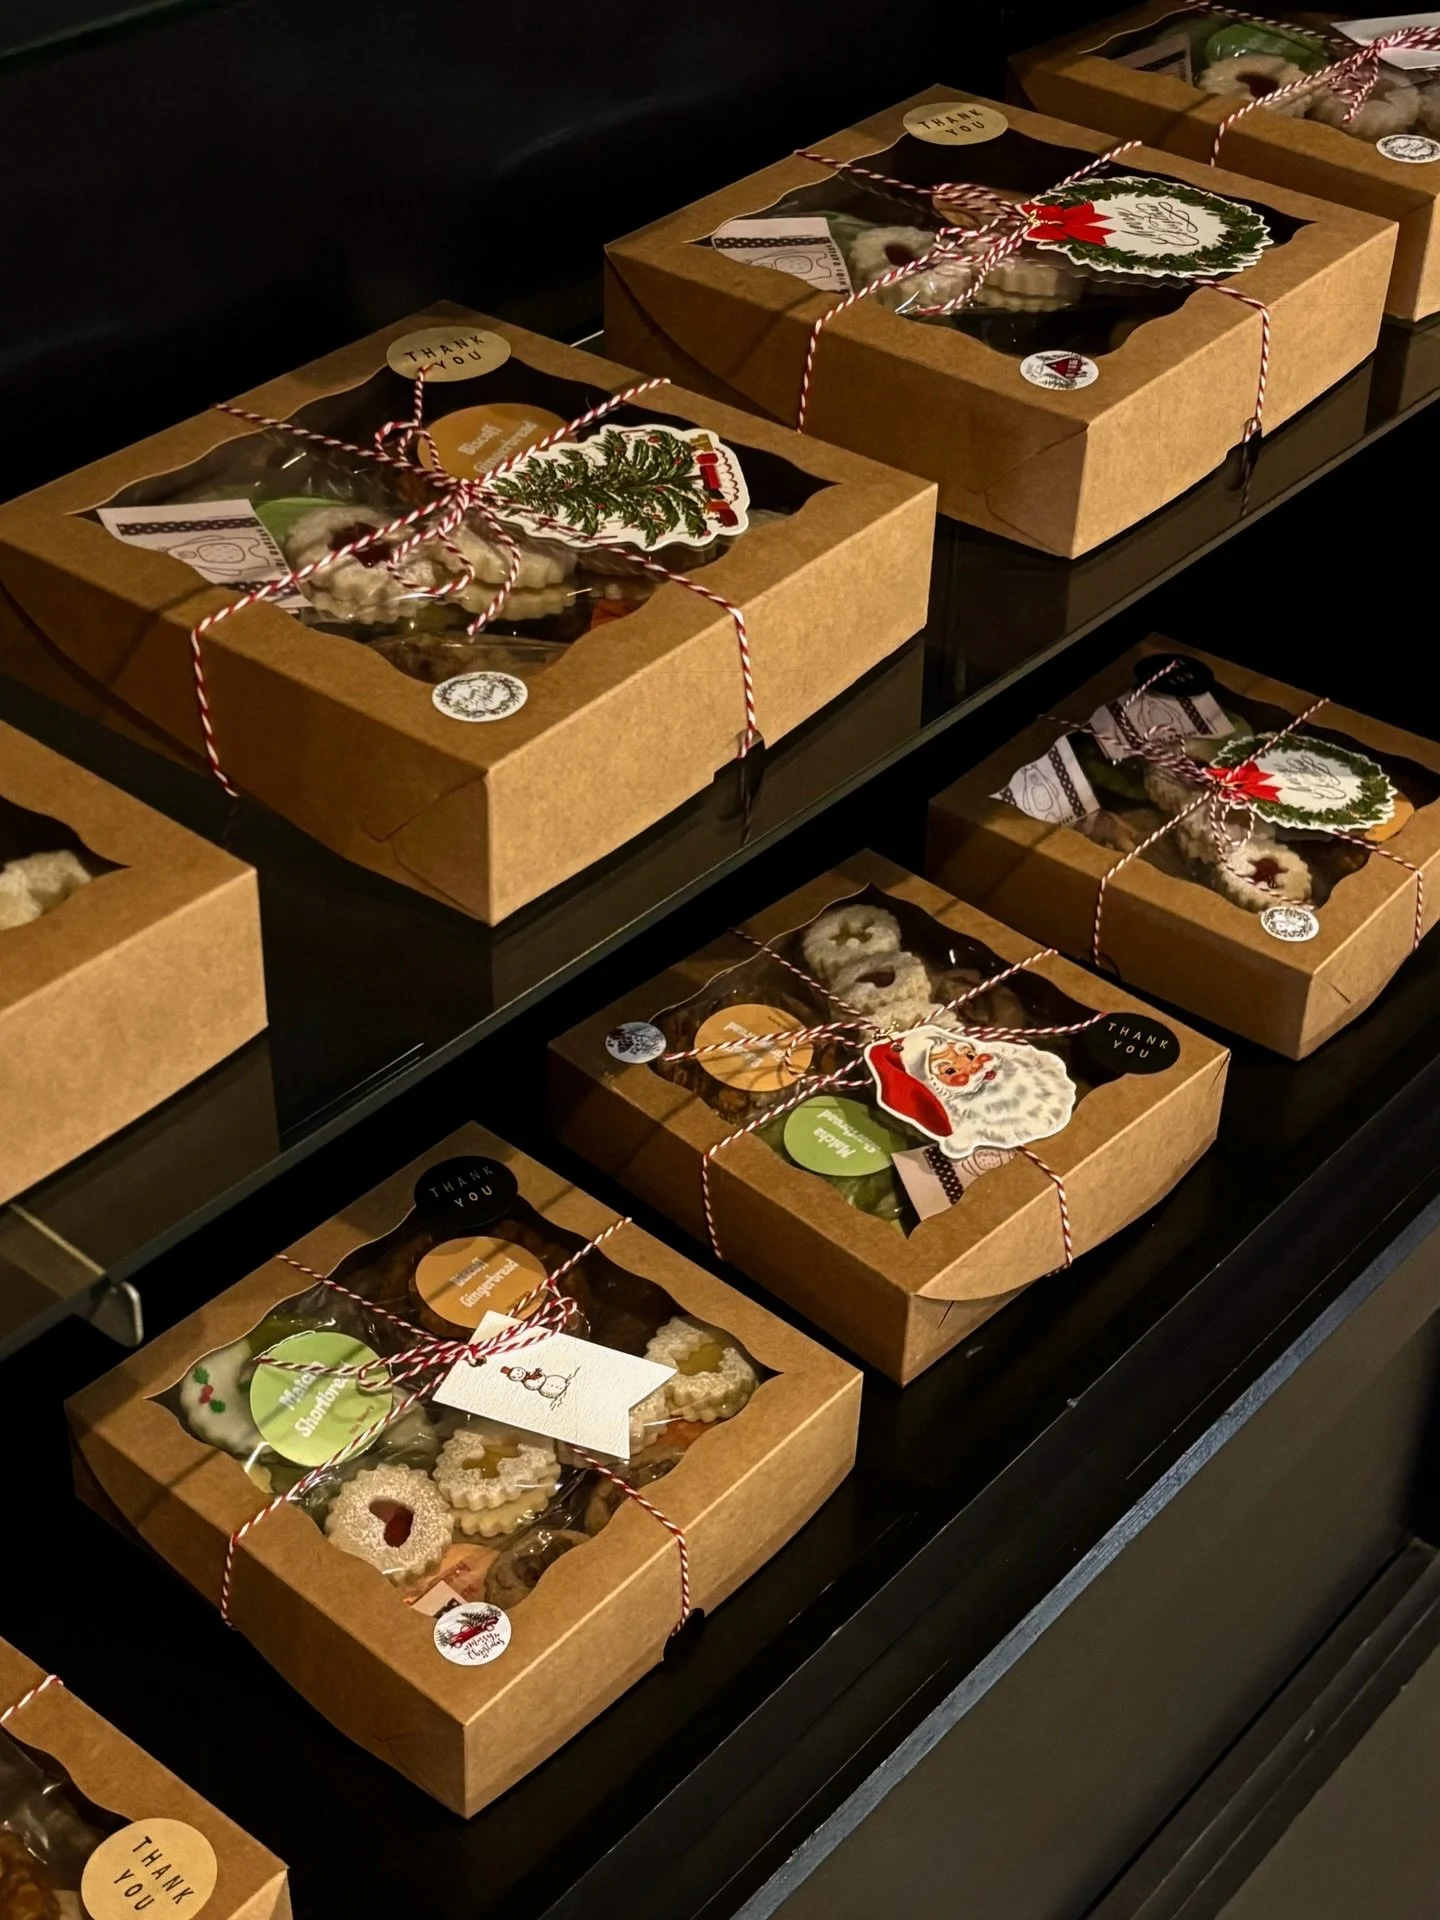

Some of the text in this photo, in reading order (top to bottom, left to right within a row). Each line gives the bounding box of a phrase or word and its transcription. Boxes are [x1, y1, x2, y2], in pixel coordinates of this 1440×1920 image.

[917, 108, 984, 130] THANK
[945, 121, 985, 137] YOU
[403, 335, 485, 362] THANK
[434, 350, 482, 370] YOU
[1108, 1022, 1169, 1049] THANK
[1113, 1039, 1150, 1058] YOU
[813, 1126, 857, 1159] Matcha
[428, 1165, 494, 1198] THANK
[453, 1185, 493, 1208] YOU
[449, 1256, 489, 1288] Biscoff
[459, 1257, 519, 1309] Gingerbread
[132, 1835, 194, 1905] THANK
[113, 1868, 155, 1911] YOU
